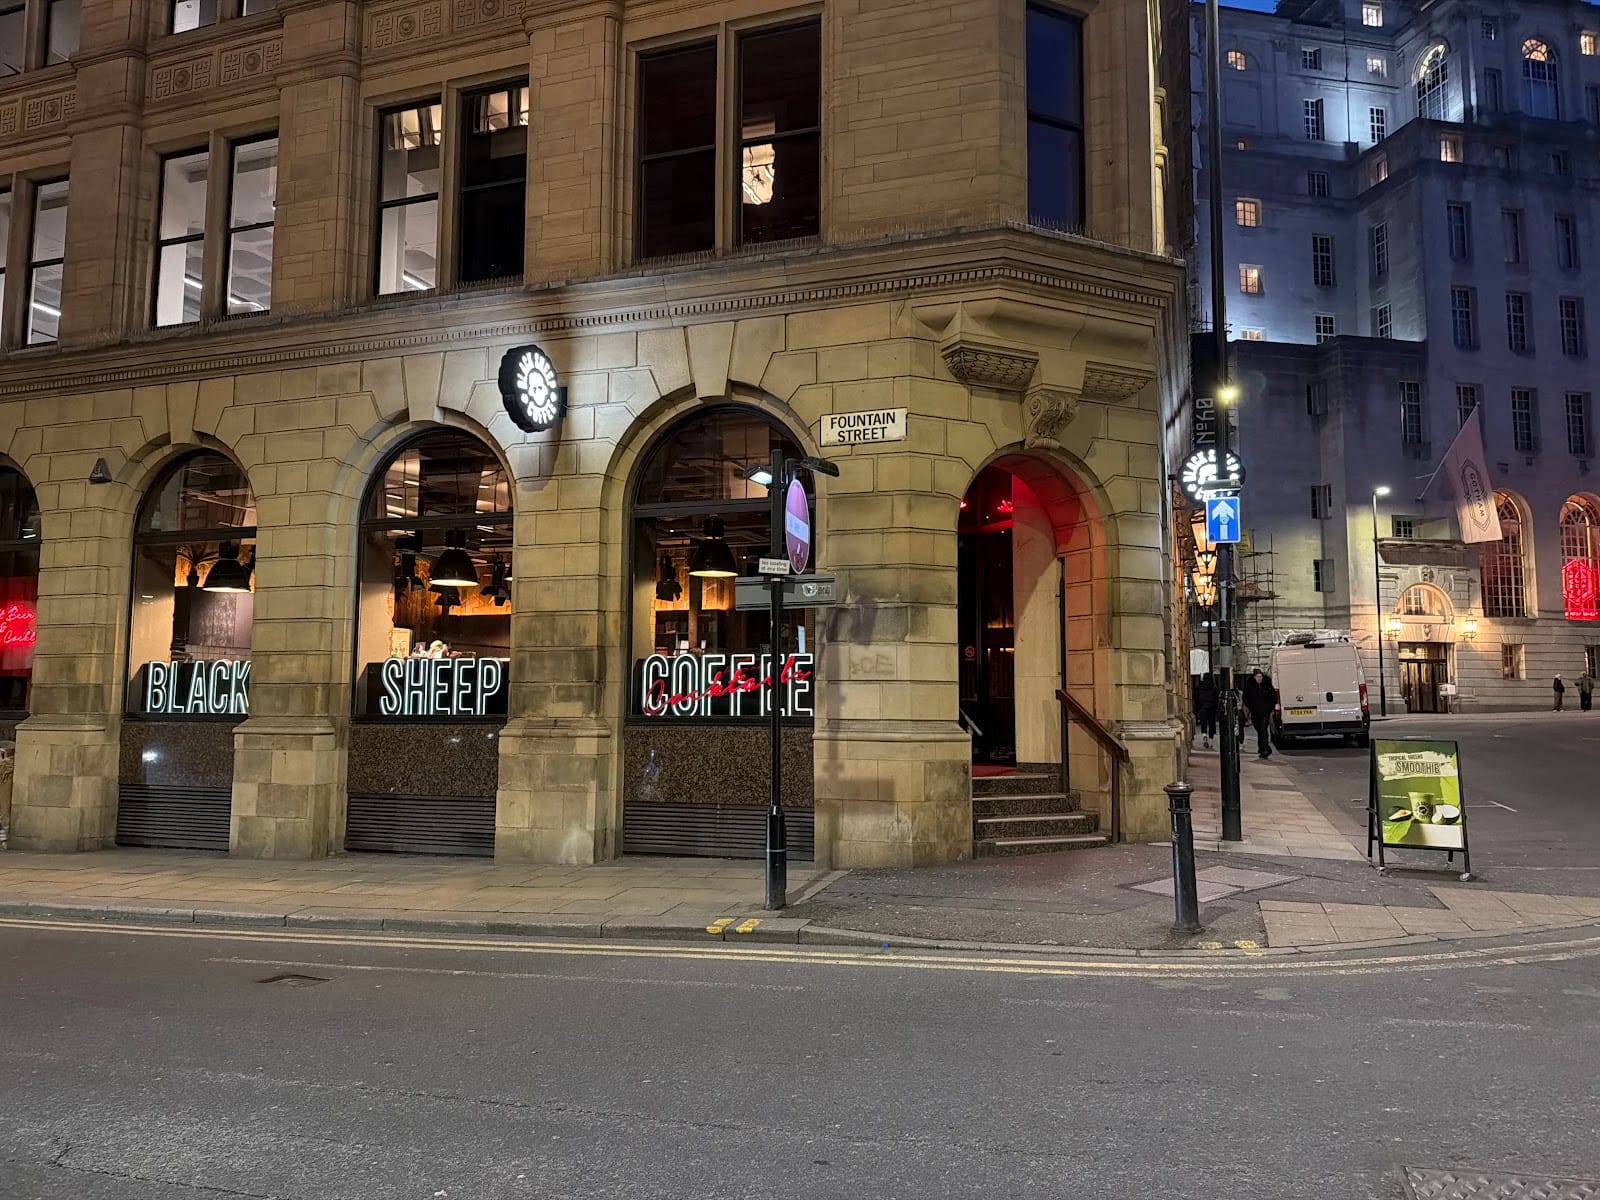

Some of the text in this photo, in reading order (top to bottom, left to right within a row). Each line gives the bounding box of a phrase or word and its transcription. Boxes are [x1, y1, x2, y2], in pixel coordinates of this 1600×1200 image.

[830, 412, 896, 429] FOUNTAIN
[837, 426, 888, 443] STREET
[1470, 473, 1485, 517] GOTHAM
[146, 659, 251, 713] BLACK
[380, 657, 501, 715] SHEEP
[643, 653, 814, 716] COFFEE
[1395, 761, 1441, 775] SMOOTHIE
